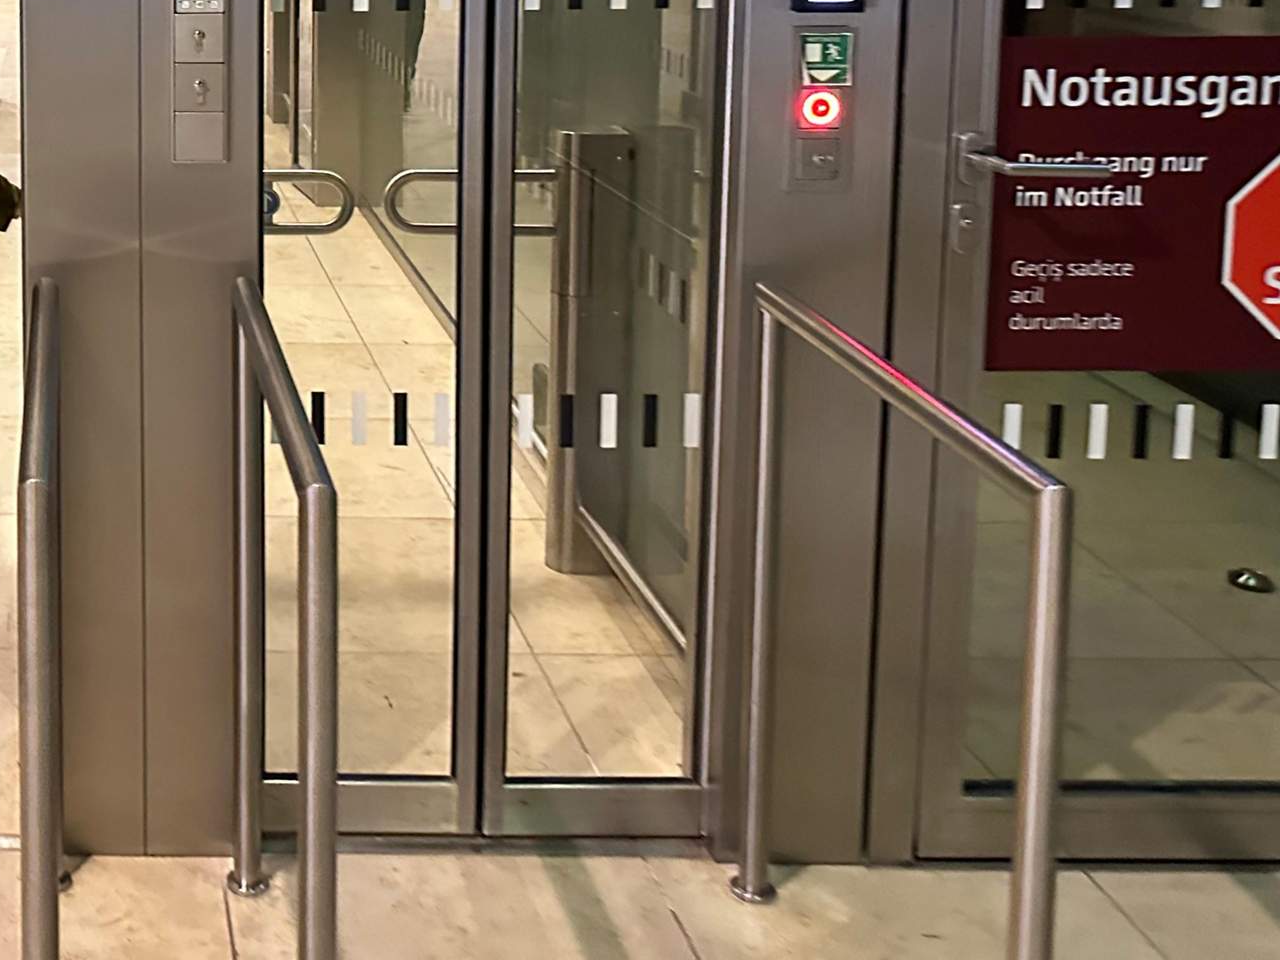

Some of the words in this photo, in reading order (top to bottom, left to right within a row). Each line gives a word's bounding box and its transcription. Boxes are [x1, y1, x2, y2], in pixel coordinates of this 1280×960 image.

[1161, 156, 1209, 172] nur
[1015, 185, 1048, 207] im
[1054, 185, 1144, 207] Notfall
[1066, 259, 1135, 277] sadece
[1009, 285, 1046, 304] acil
[1008, 312, 1124, 330] durumlarda
